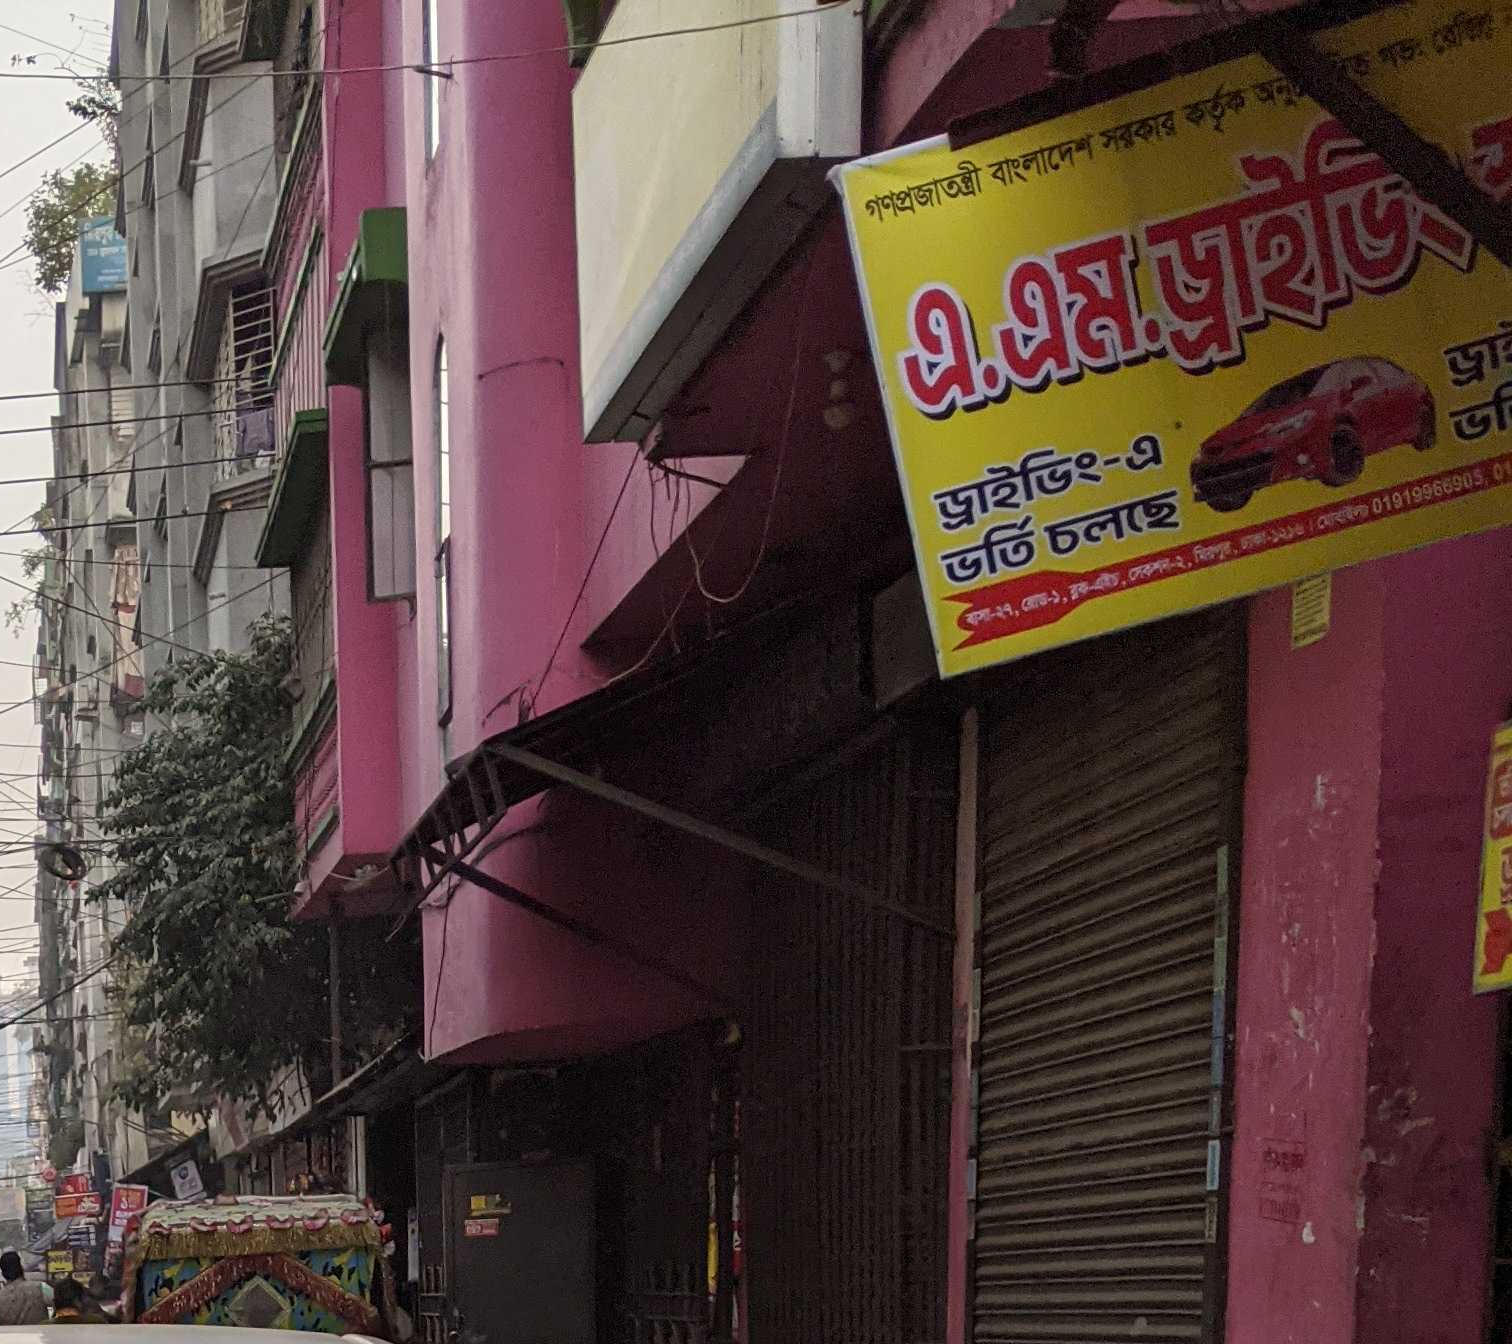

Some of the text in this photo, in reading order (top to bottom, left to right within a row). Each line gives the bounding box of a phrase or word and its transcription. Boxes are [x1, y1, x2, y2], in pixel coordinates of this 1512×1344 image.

[988, 135, 1094, 186] বাংলাদেশ
[1099, 110, 1176, 152] সরকার
[934, 434, 1163, 531] ড্রাইভিং-এ
[940, 489, 1181, 583] ভর্তি চলছে
